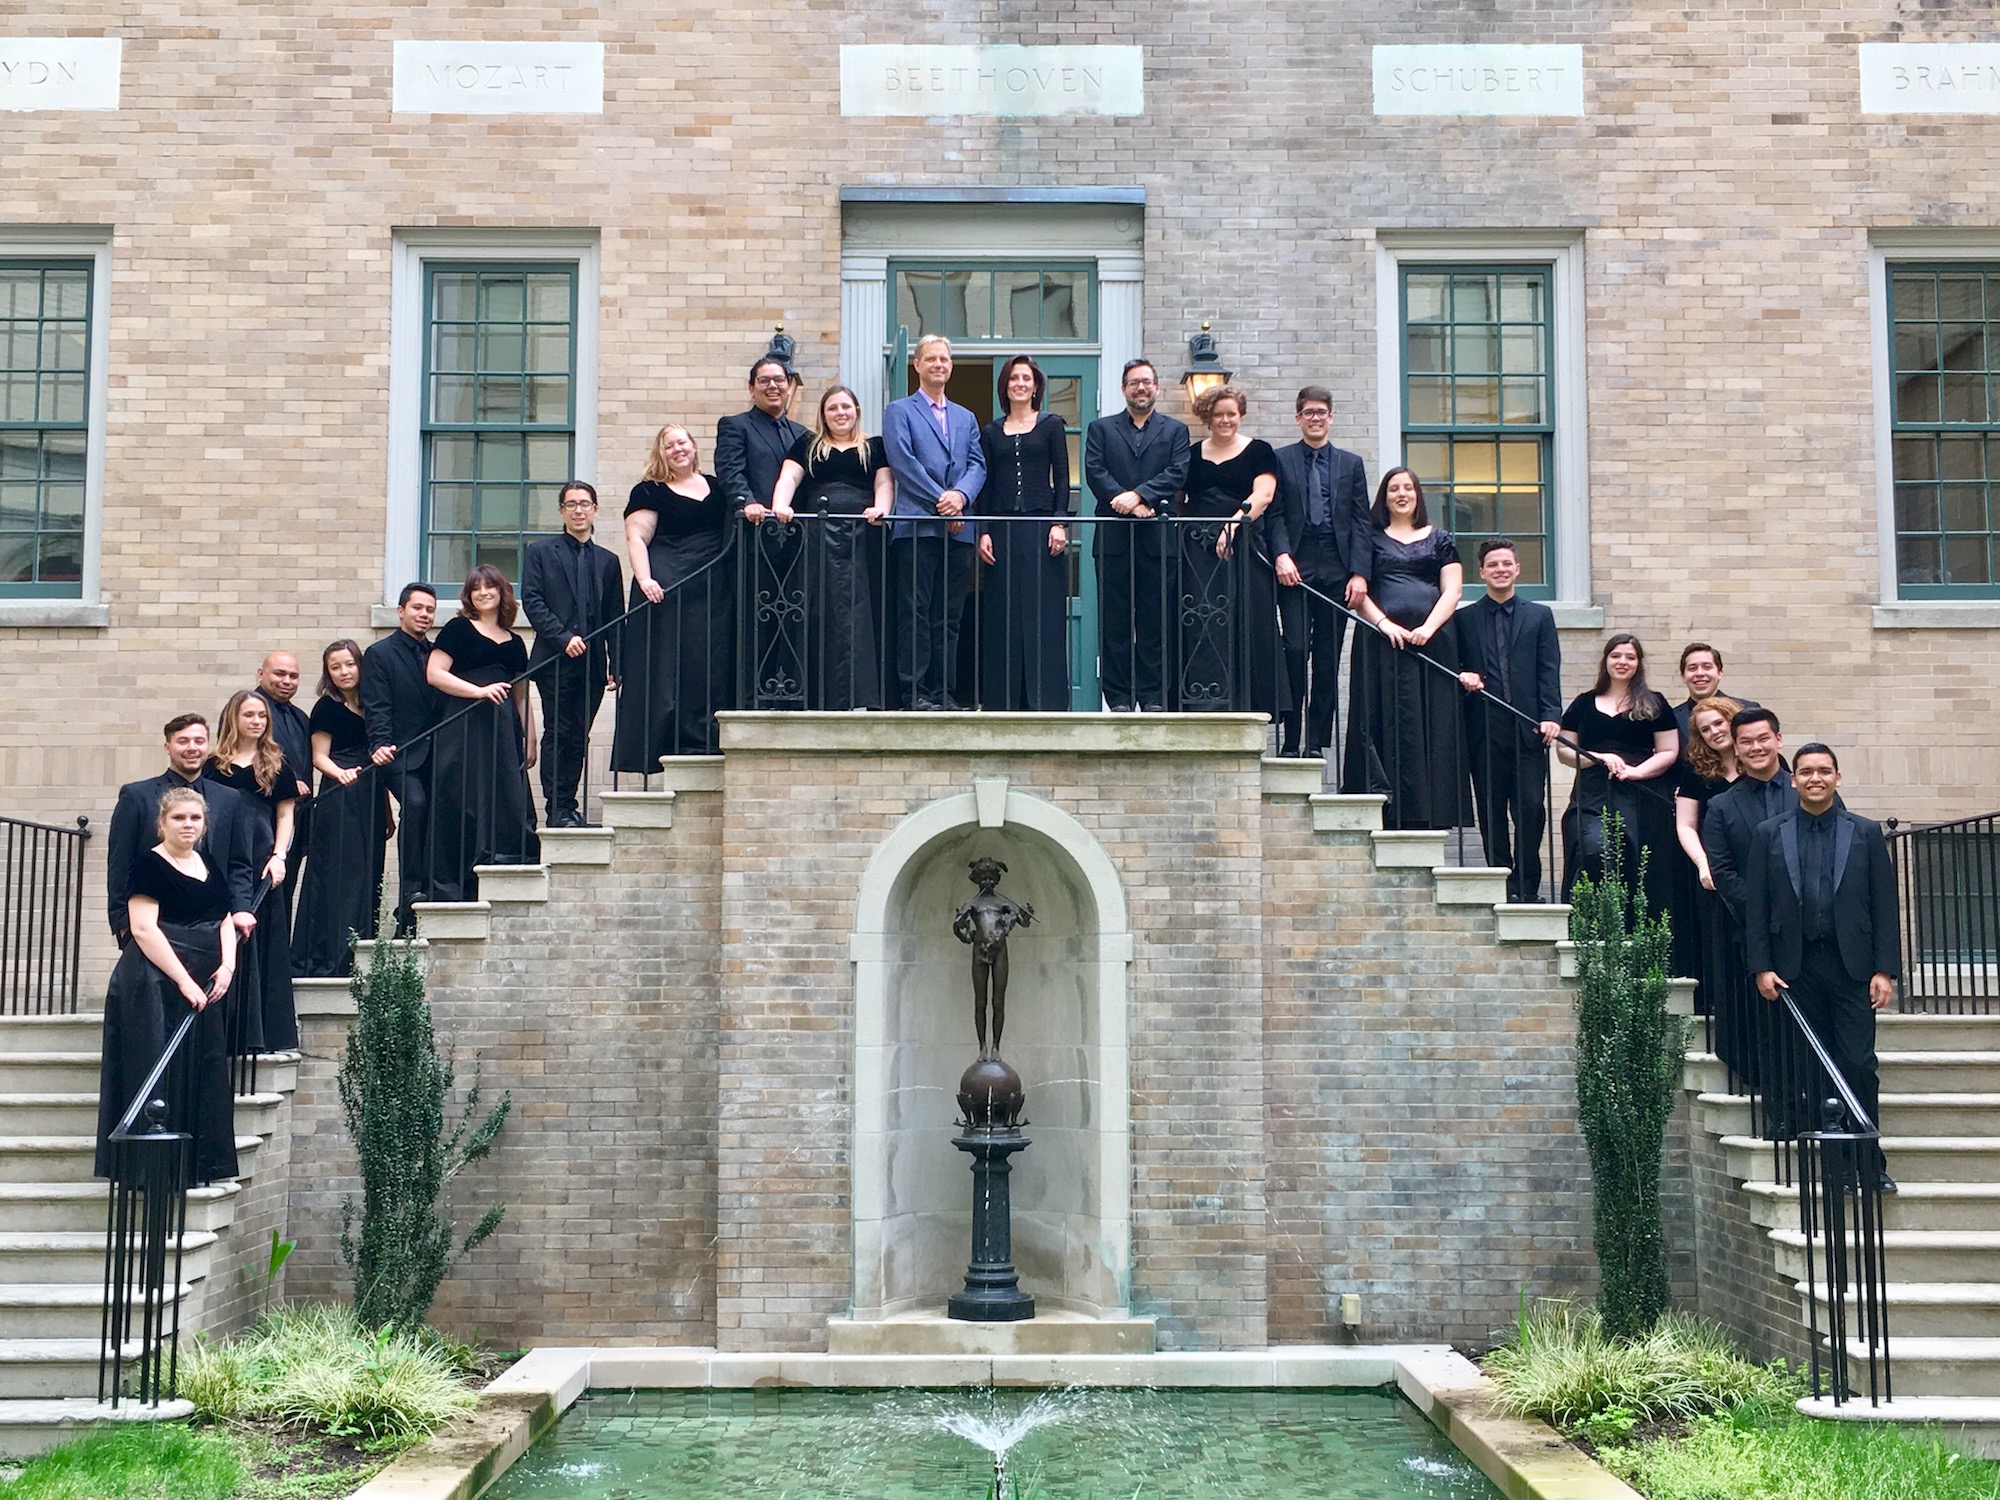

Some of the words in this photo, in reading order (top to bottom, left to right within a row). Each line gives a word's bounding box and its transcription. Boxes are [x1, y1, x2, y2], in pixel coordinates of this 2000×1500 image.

[2, 61, 78, 85] YDN
[425, 64, 572, 90] MOZART
[884, 67, 1103, 93] BEETHOVEN
[1390, 67, 1565, 92] SCHUBERT
